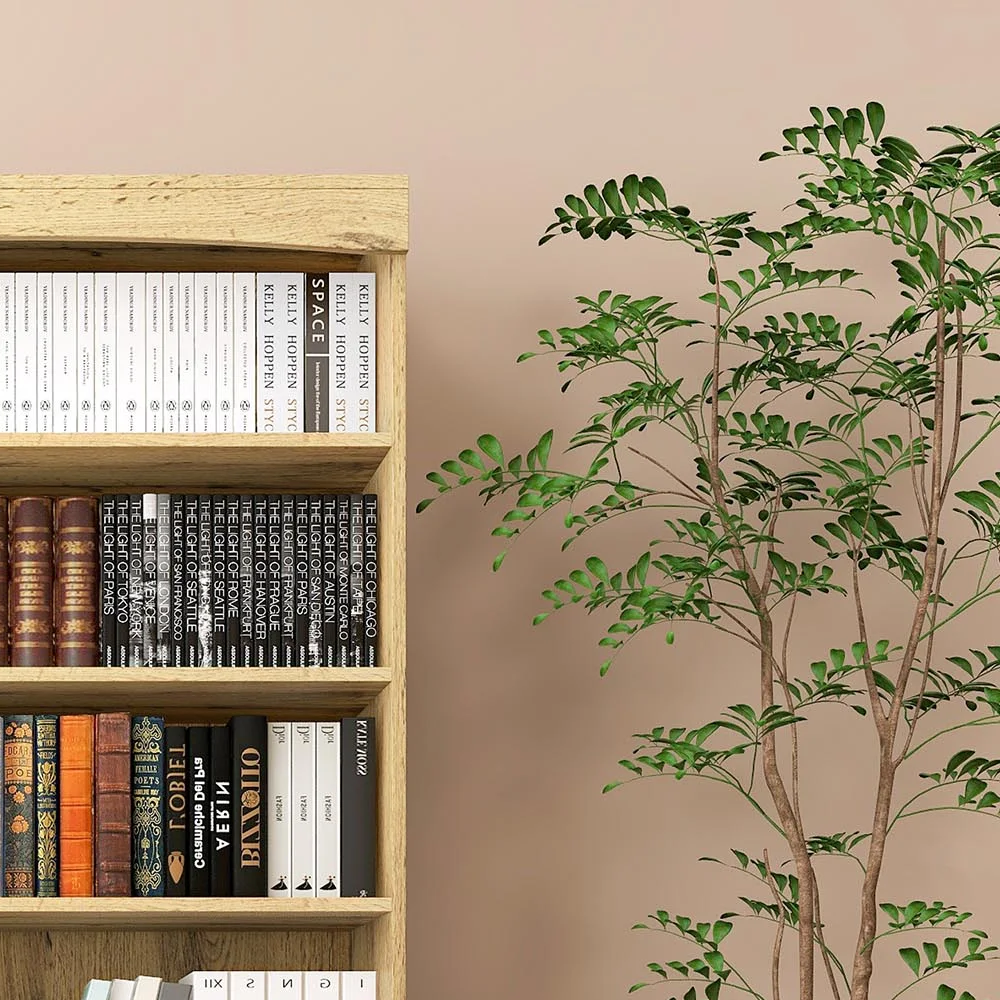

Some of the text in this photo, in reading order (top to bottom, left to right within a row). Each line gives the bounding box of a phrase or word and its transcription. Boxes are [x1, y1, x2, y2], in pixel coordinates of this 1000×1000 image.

[264, 284, 274, 326] KELLY
[287, 284, 297, 326] KELLY
[312, 278, 325, 343] SPACE
[336, 284, 346, 326] KELLY
[359, 284, 369, 326] KELLY
[264, 335, 274, 389] HOPPEN
[287, 335, 297, 389] HOPPEN
[336, 335, 346, 389] HOPPEN
[359, 335, 369, 389] HOPPEN
[131, 500, 141, 523] THE
[117, 500, 128, 623] THE LIGHT OF TOKYO
[131, 525, 141, 558] LIGHT
[131, 559, 141, 575] OF
[214, 500, 225, 633] THE LIGHT OF SEATTLE
[228, 500, 238, 618] THE LIGHT OF ROME
[269, 500, 280, 631] THE LIGHT OF PRAGUE
[297, 500, 308, 615] THE LIGHT OF PARIS
[325, 500, 335, 623] THE LIGHT OF AUSTIN
[173, 500, 182, 641] THE LIGHT OF SAN FRANCISCO
[283, 500, 294, 639] THE LIGHT OF FRANKFURT
[339, 500, 348, 641] THE LIGHT OF MONTE CARLO
[366, 500, 377, 638] THE LIGHT OF CHICAGO
[134, 776, 160, 784] POETS
